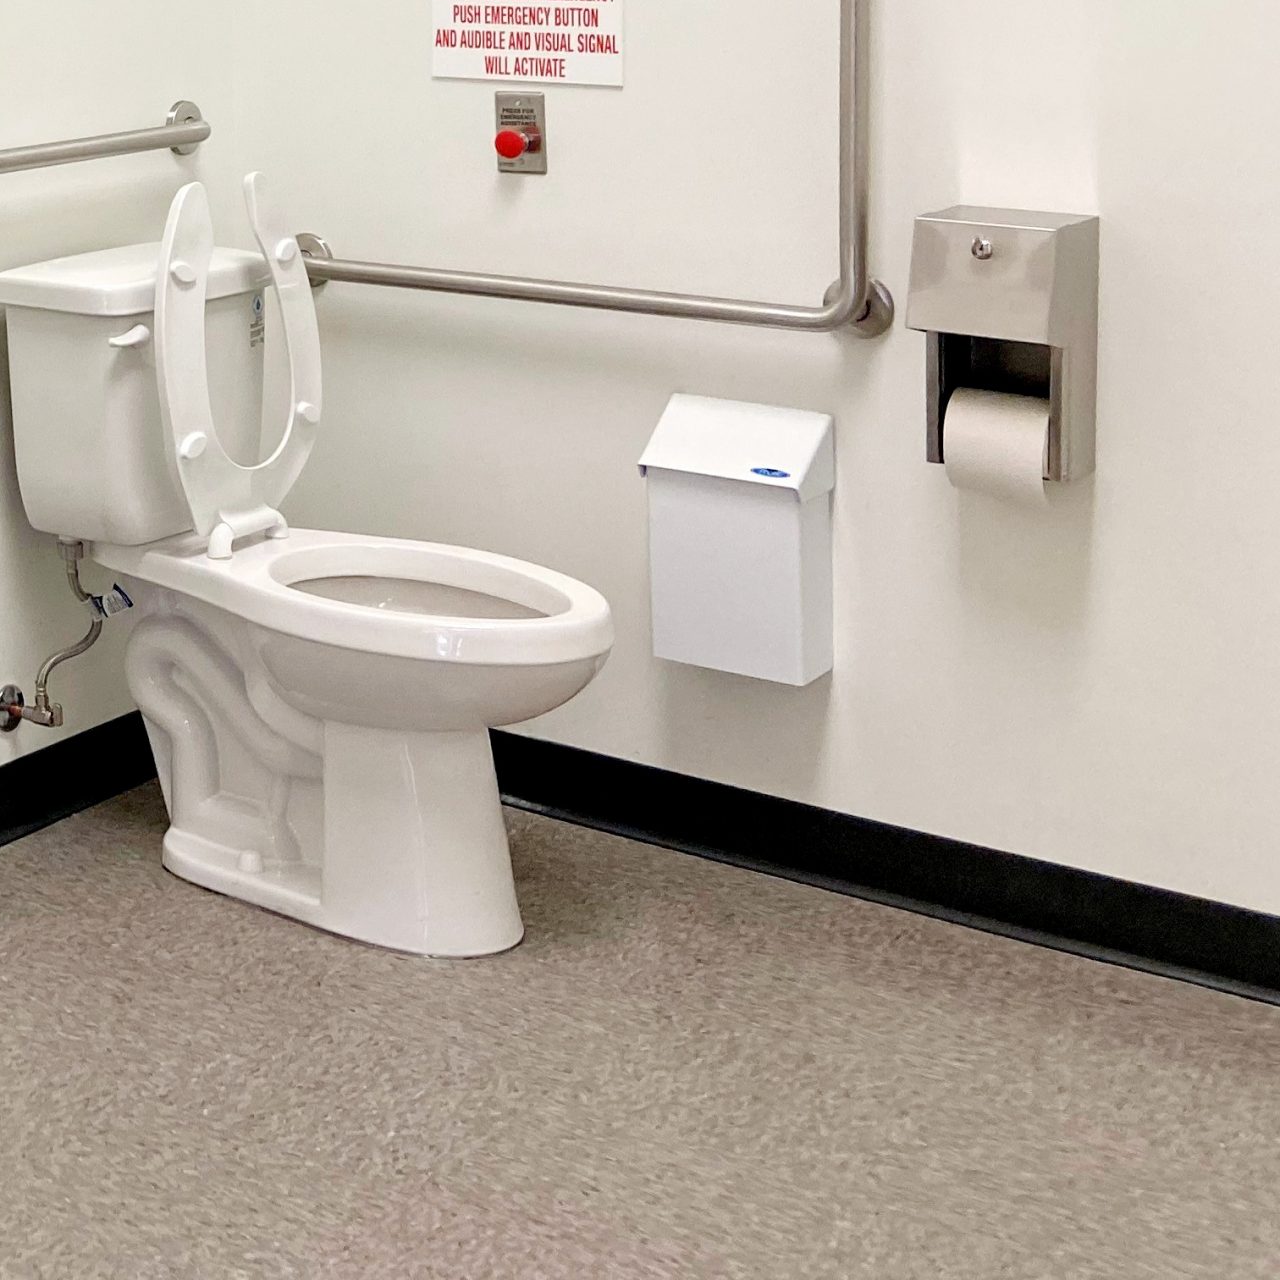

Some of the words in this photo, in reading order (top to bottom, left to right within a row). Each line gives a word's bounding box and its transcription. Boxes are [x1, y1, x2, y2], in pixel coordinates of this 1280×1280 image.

[453, 4, 481, 24] PUSH
[484, 5, 550, 26] EMERGENCY
[554, 7, 599, 27] BUTTON
[435, 29, 457, 48] AND
[460, 30, 505, 50] AUDIBLE
[508, 31, 531, 51] AND
[534, 32, 574, 53] VISUAL
[577, 33, 619, 54] SIGNAL
[484, 55, 510, 75] WILL
[513, 57, 566, 77] ACTIVATE
